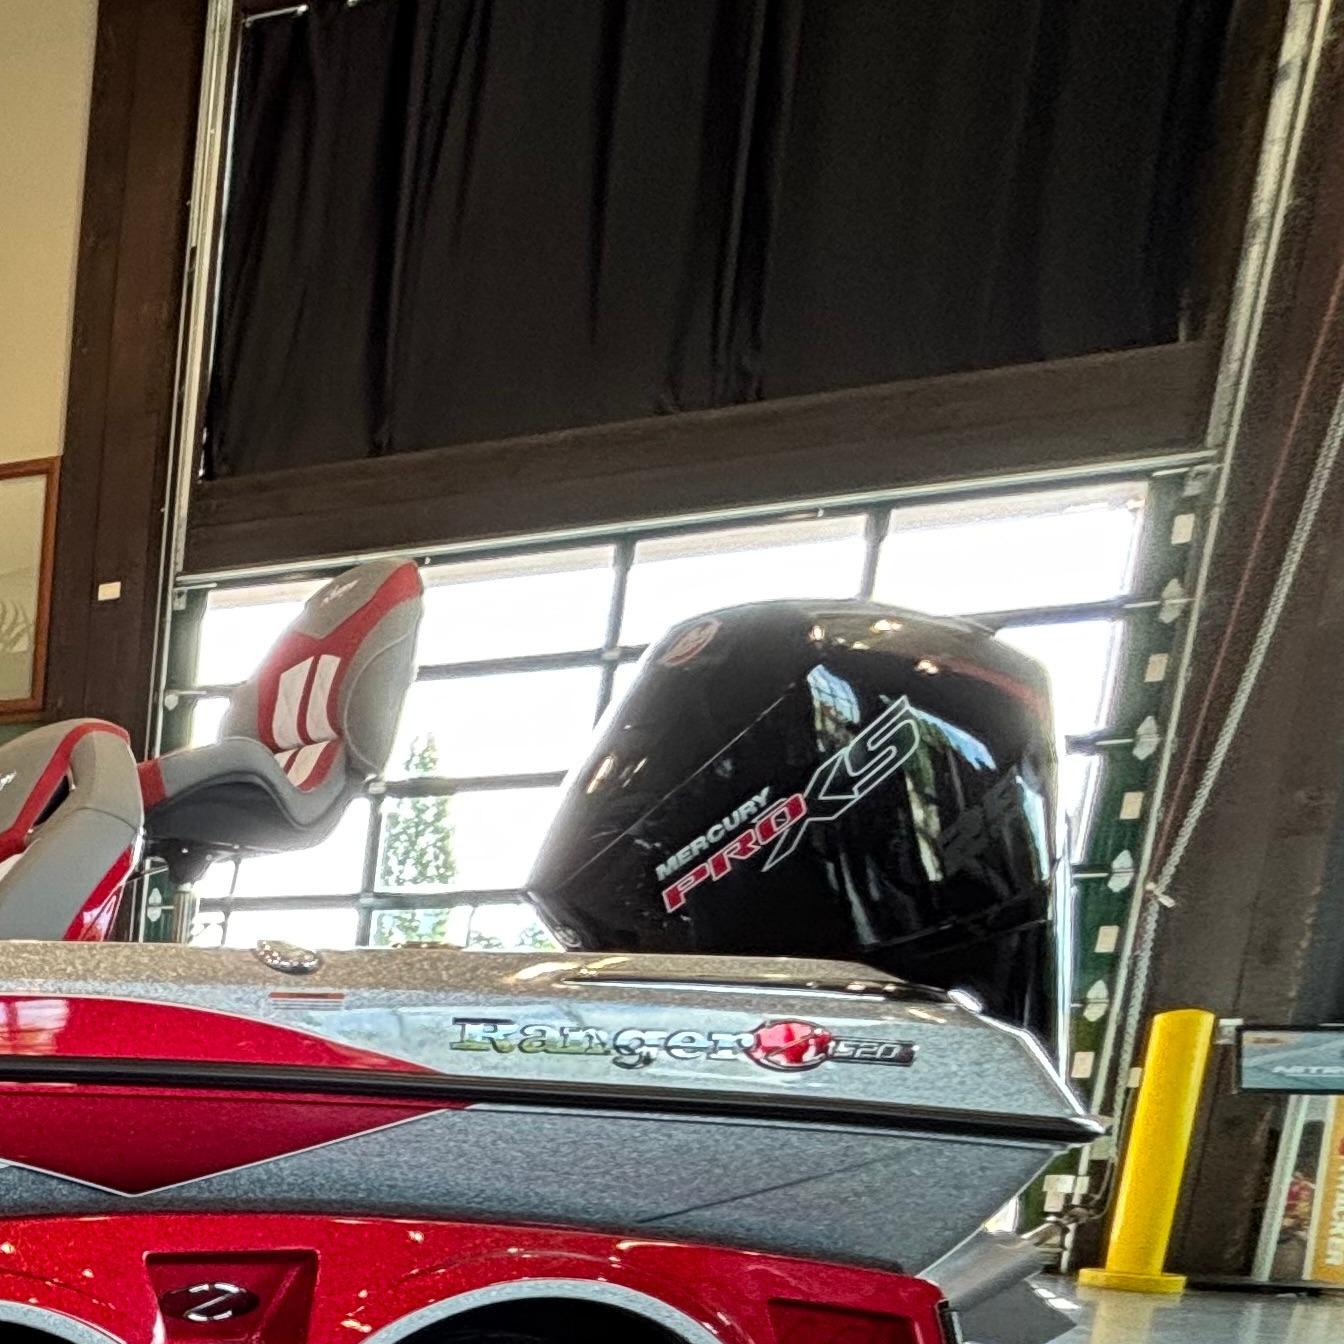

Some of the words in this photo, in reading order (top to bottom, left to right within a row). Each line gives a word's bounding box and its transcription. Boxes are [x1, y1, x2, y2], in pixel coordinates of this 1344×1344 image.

[655, 786, 770, 881] MERCURY
[662, 793, 807, 913] PRO
[762, 695, 920, 873] XS
[449, 1017, 755, 1069] Ranger
